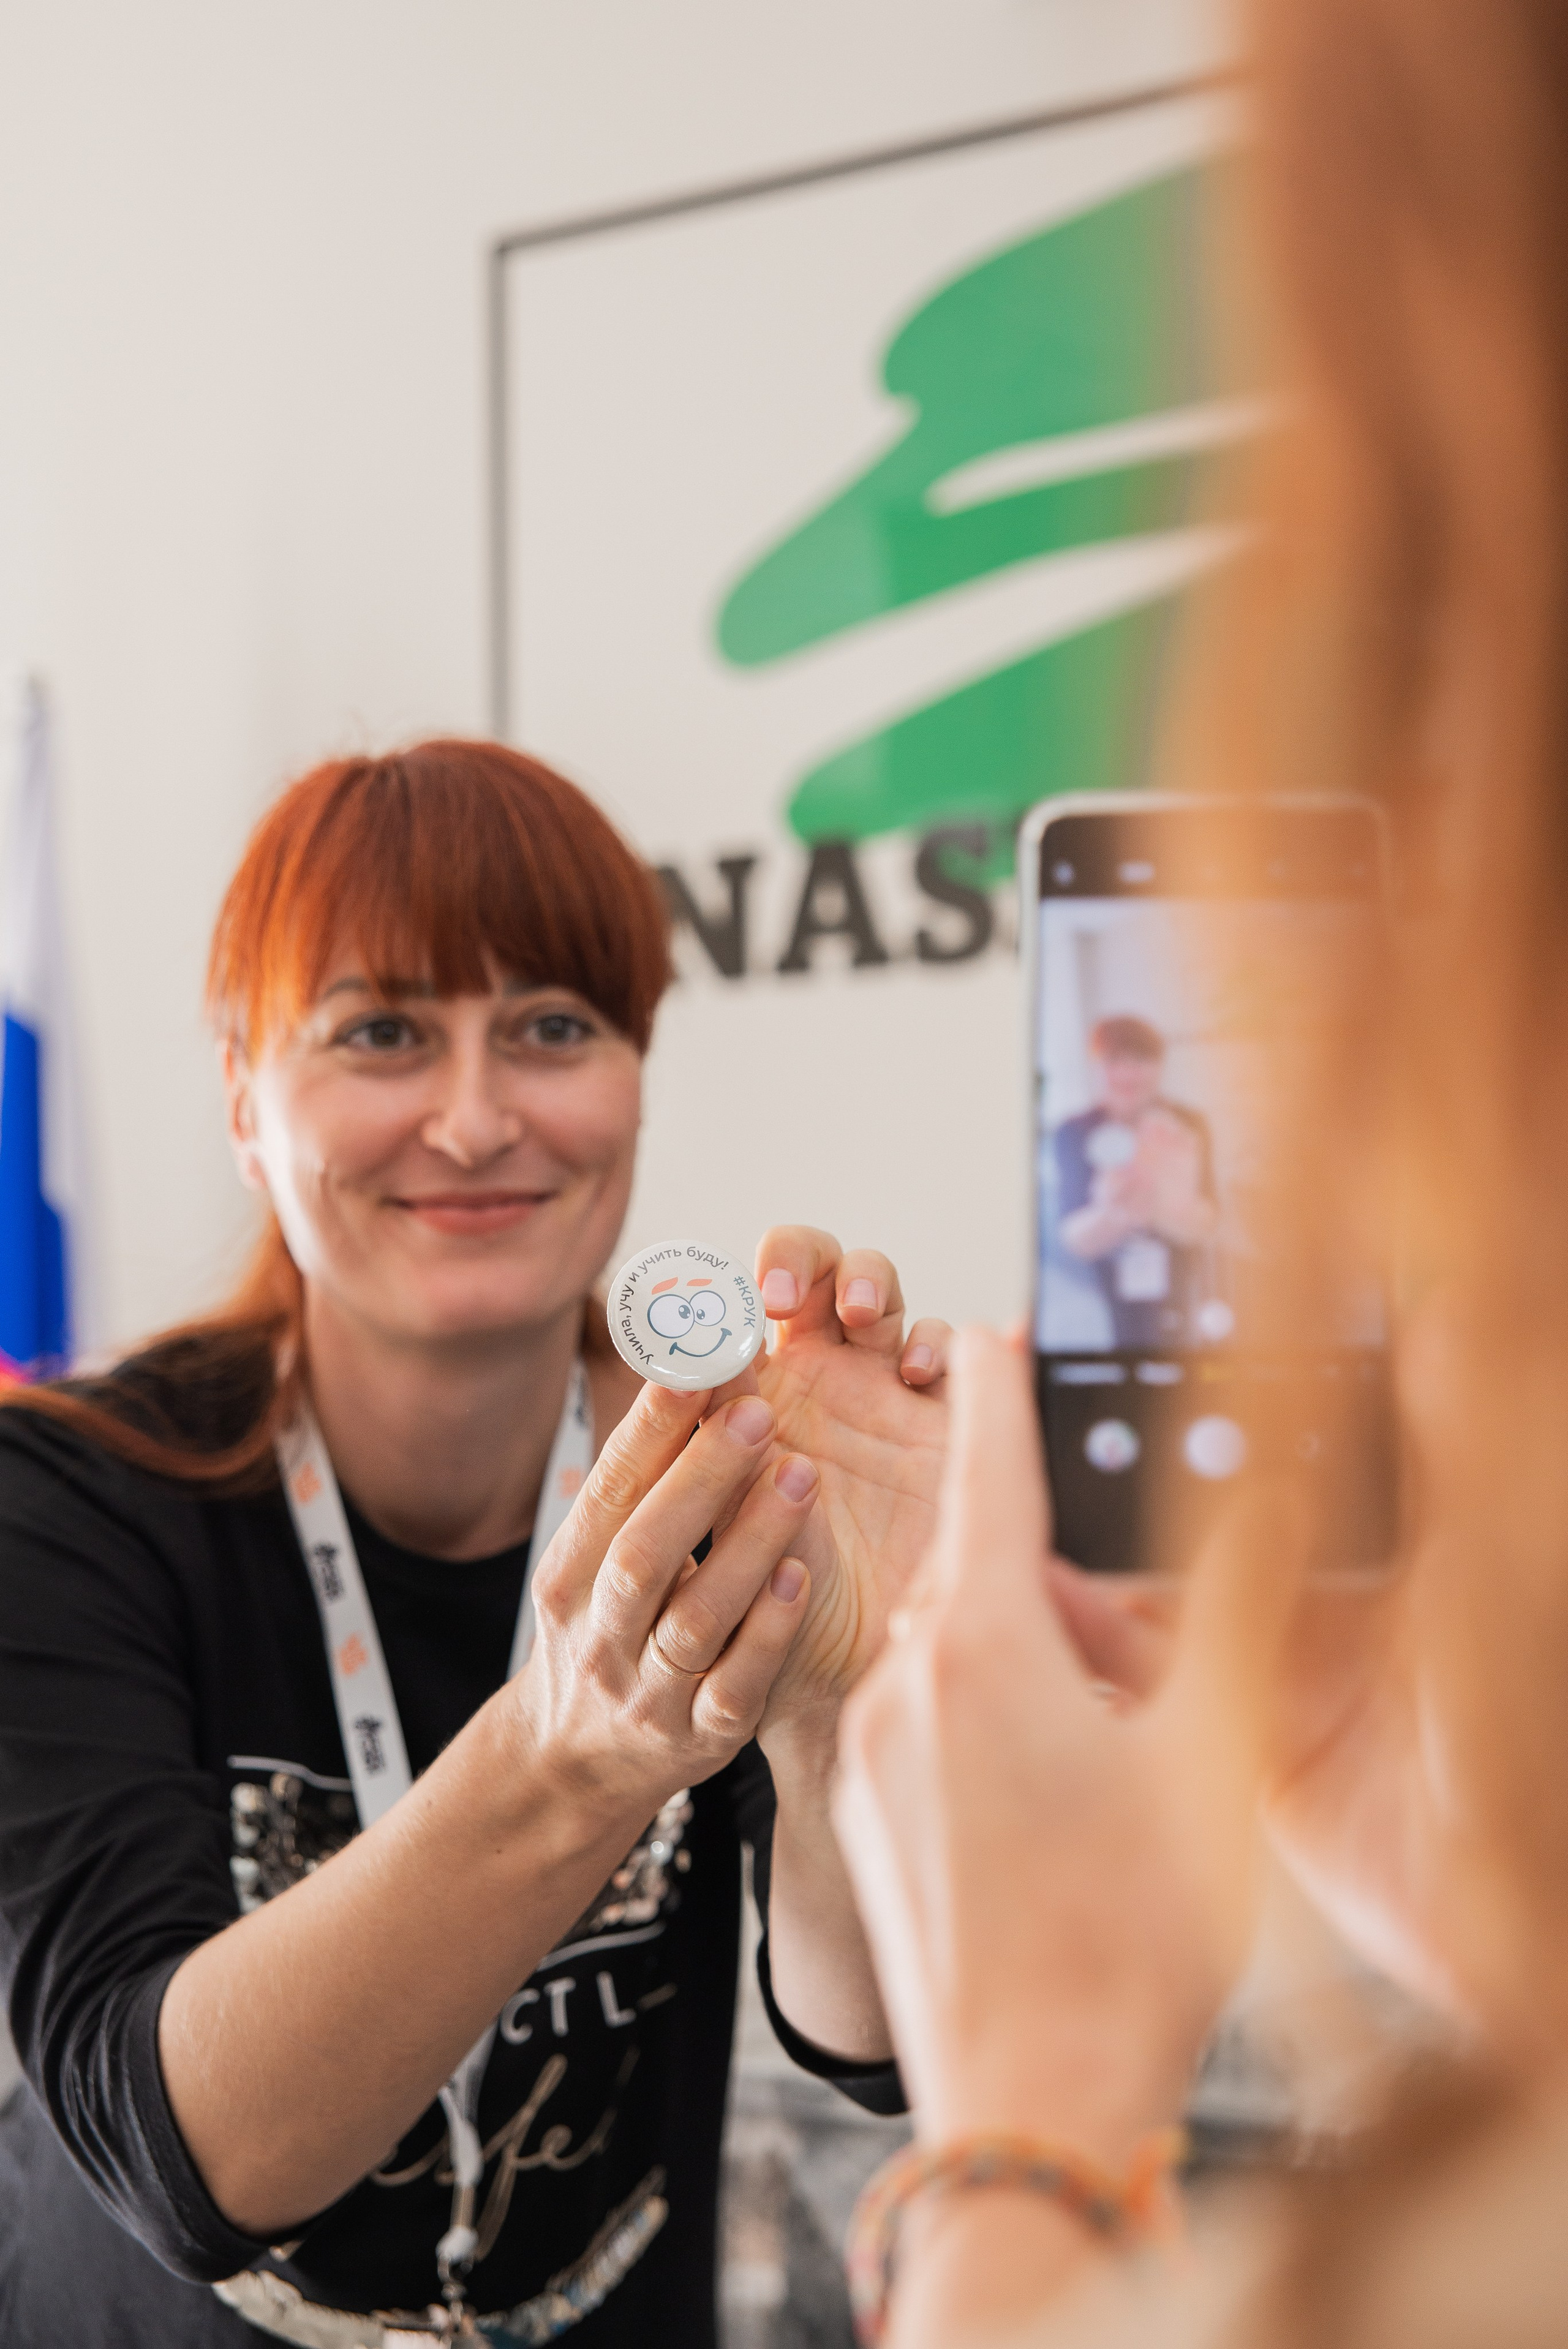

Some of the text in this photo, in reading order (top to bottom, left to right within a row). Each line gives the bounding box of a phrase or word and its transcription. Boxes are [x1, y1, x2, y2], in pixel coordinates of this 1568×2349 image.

[653, 820, 995, 979] NAS
[619, 1246, 729, 1365] Учила, учу и учить буду!
[733, 1276, 756, 1329] #КРУК
[500, 1970, 636, 2045] CTL
